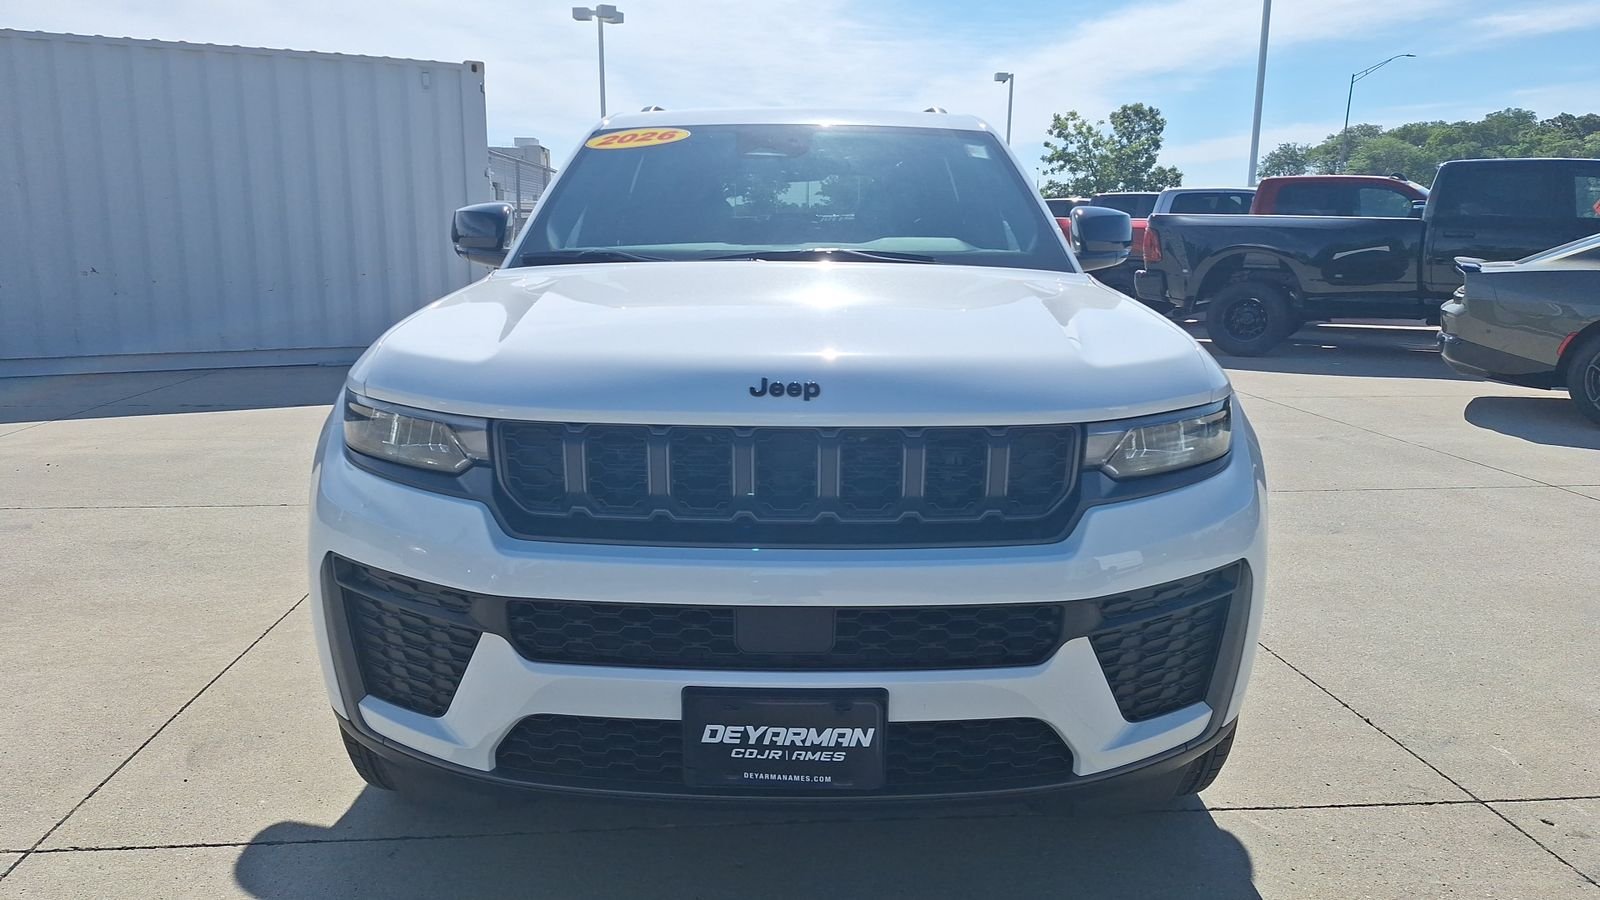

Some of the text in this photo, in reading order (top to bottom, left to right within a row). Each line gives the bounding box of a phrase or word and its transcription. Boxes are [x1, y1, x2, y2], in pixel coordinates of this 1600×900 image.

[596, 130, 678, 146] 2026
[749, 377, 821, 401] Jeep
[701, 724, 875, 747] DEYARMAN
[791, 750, 846, 762] AMES
[743, 771, 832, 783] DEYARMANAMES.COM
